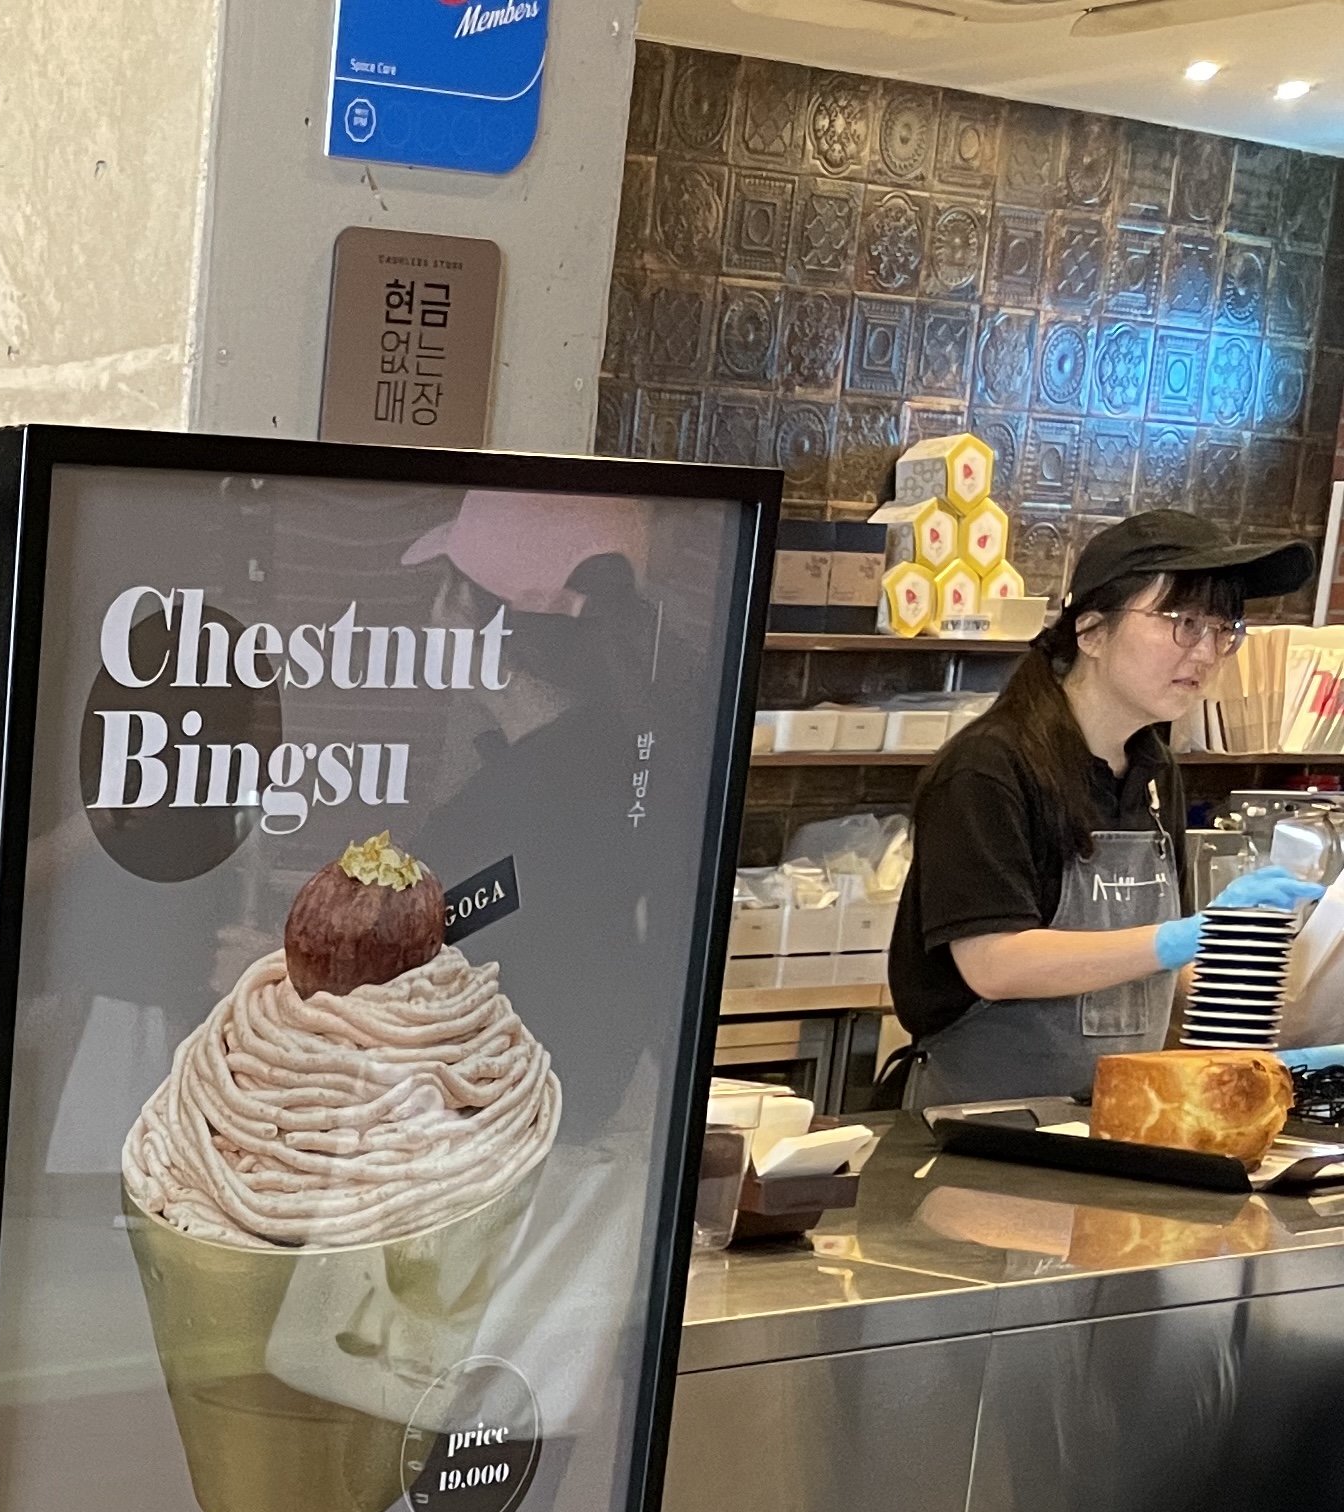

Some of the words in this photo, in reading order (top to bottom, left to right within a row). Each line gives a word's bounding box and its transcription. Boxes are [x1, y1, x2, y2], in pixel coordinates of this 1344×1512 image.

[454, 0, 539, 38] Members
[385, 279, 451, 328] 현금
[381, 330, 446, 377] 없는
[375, 381, 444, 425] 매장
[100, 586, 513, 691] Chestnut
[637, 731, 655, 760] 밤
[86, 710, 410, 835] Bingsu
[627, 769, 649, 828] 빙수
[447, 1422, 509, 1457] price
[438, 1463, 510, 1491] 19.000
